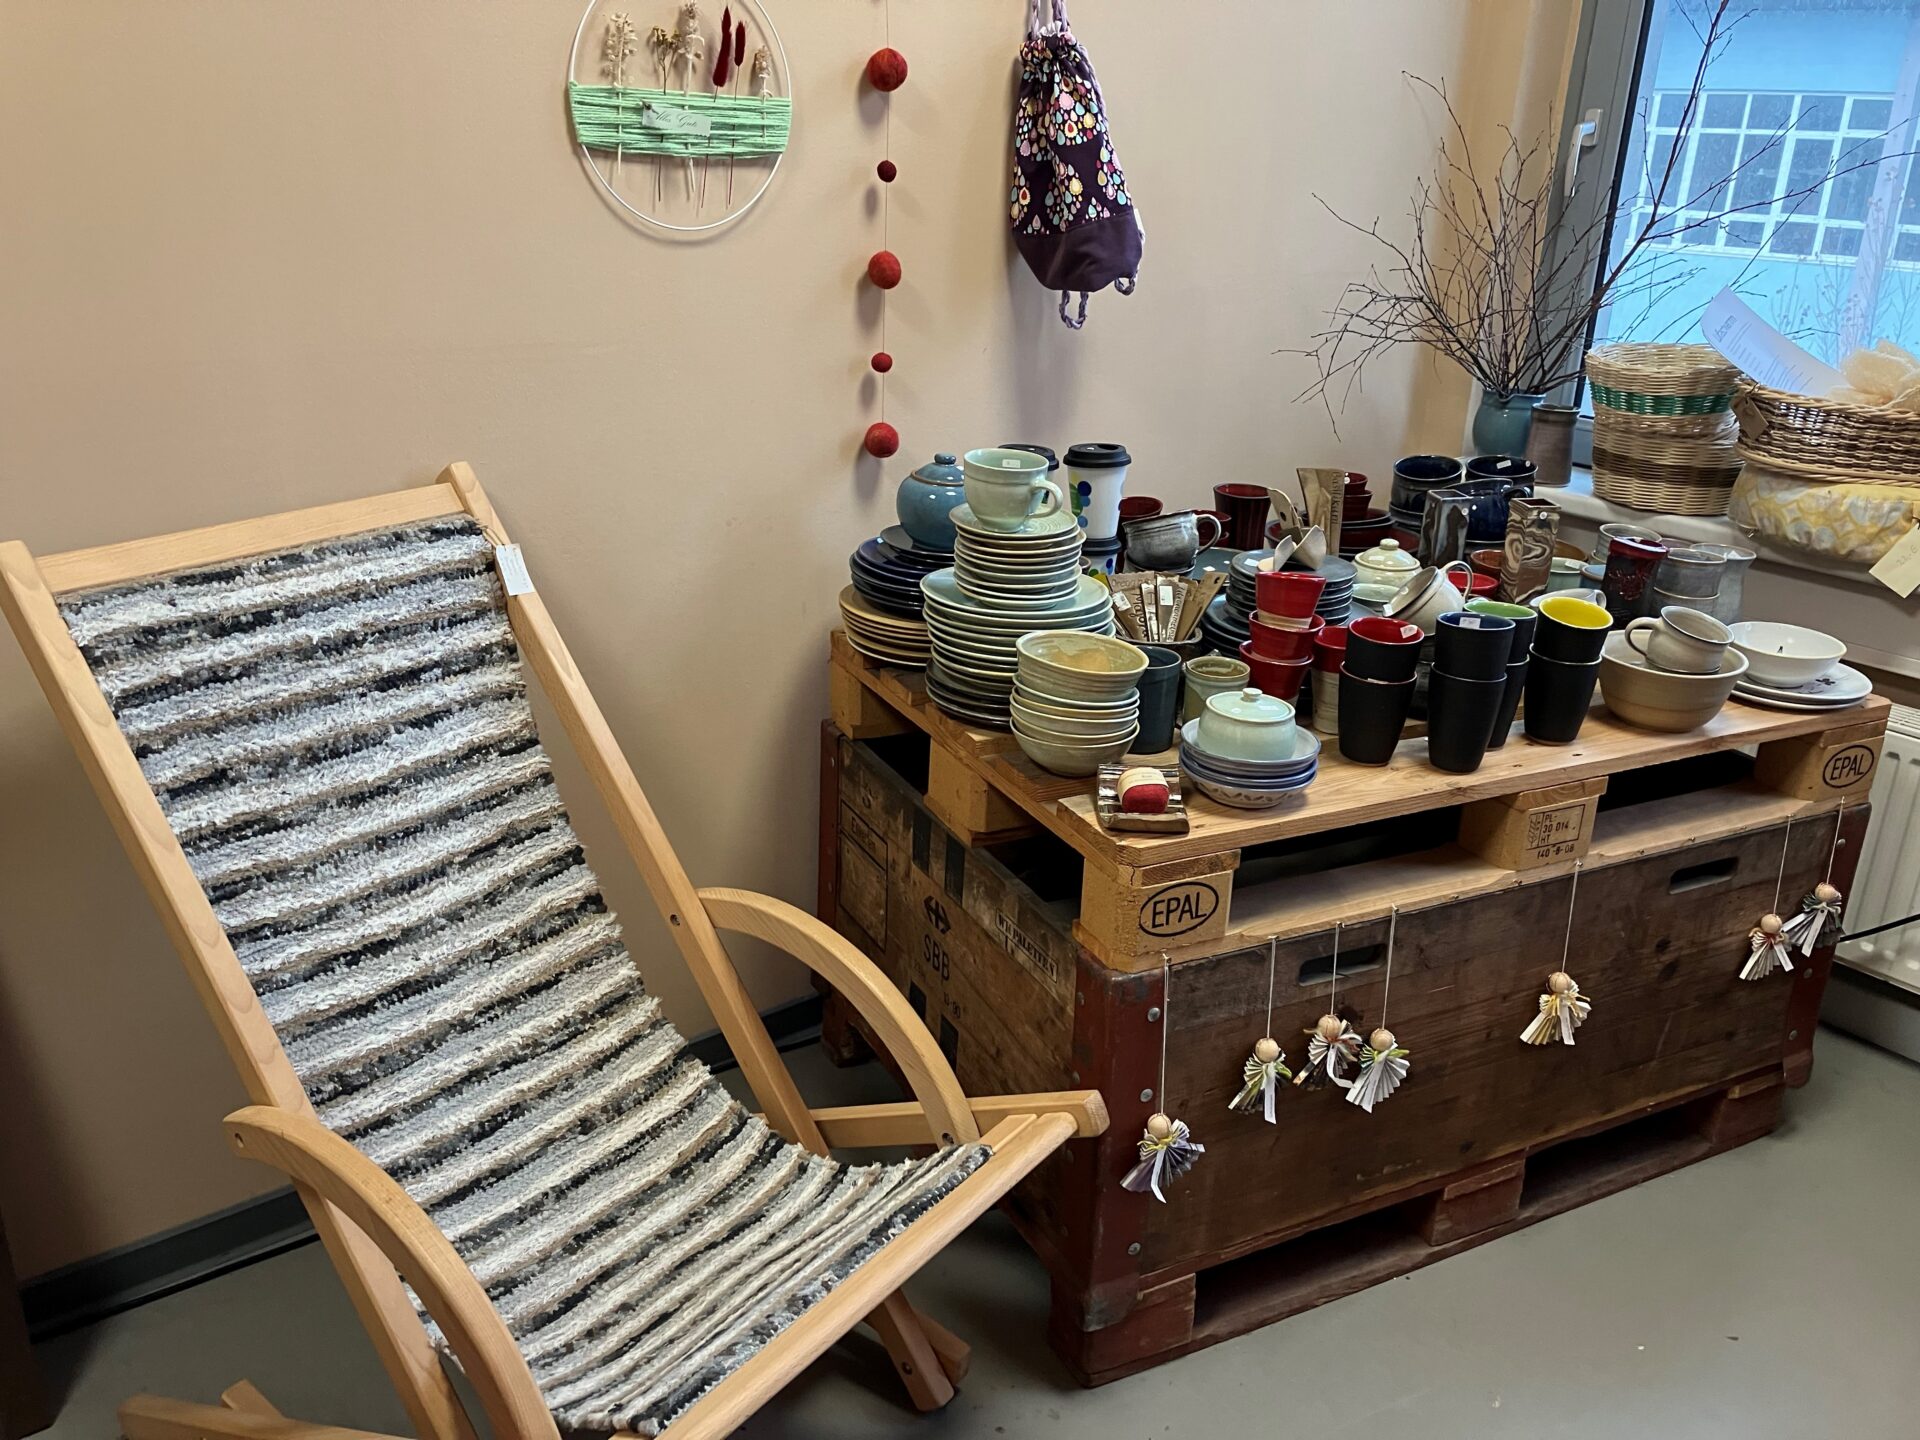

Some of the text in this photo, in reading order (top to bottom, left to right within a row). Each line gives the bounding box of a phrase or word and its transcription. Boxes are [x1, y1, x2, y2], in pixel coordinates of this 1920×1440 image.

[1829, 753, 1865, 780] EPAL
[1541, 834, 1550, 844] HT
[1151, 891, 1208, 929] EPAL
[923, 933, 951, 981] SBB
